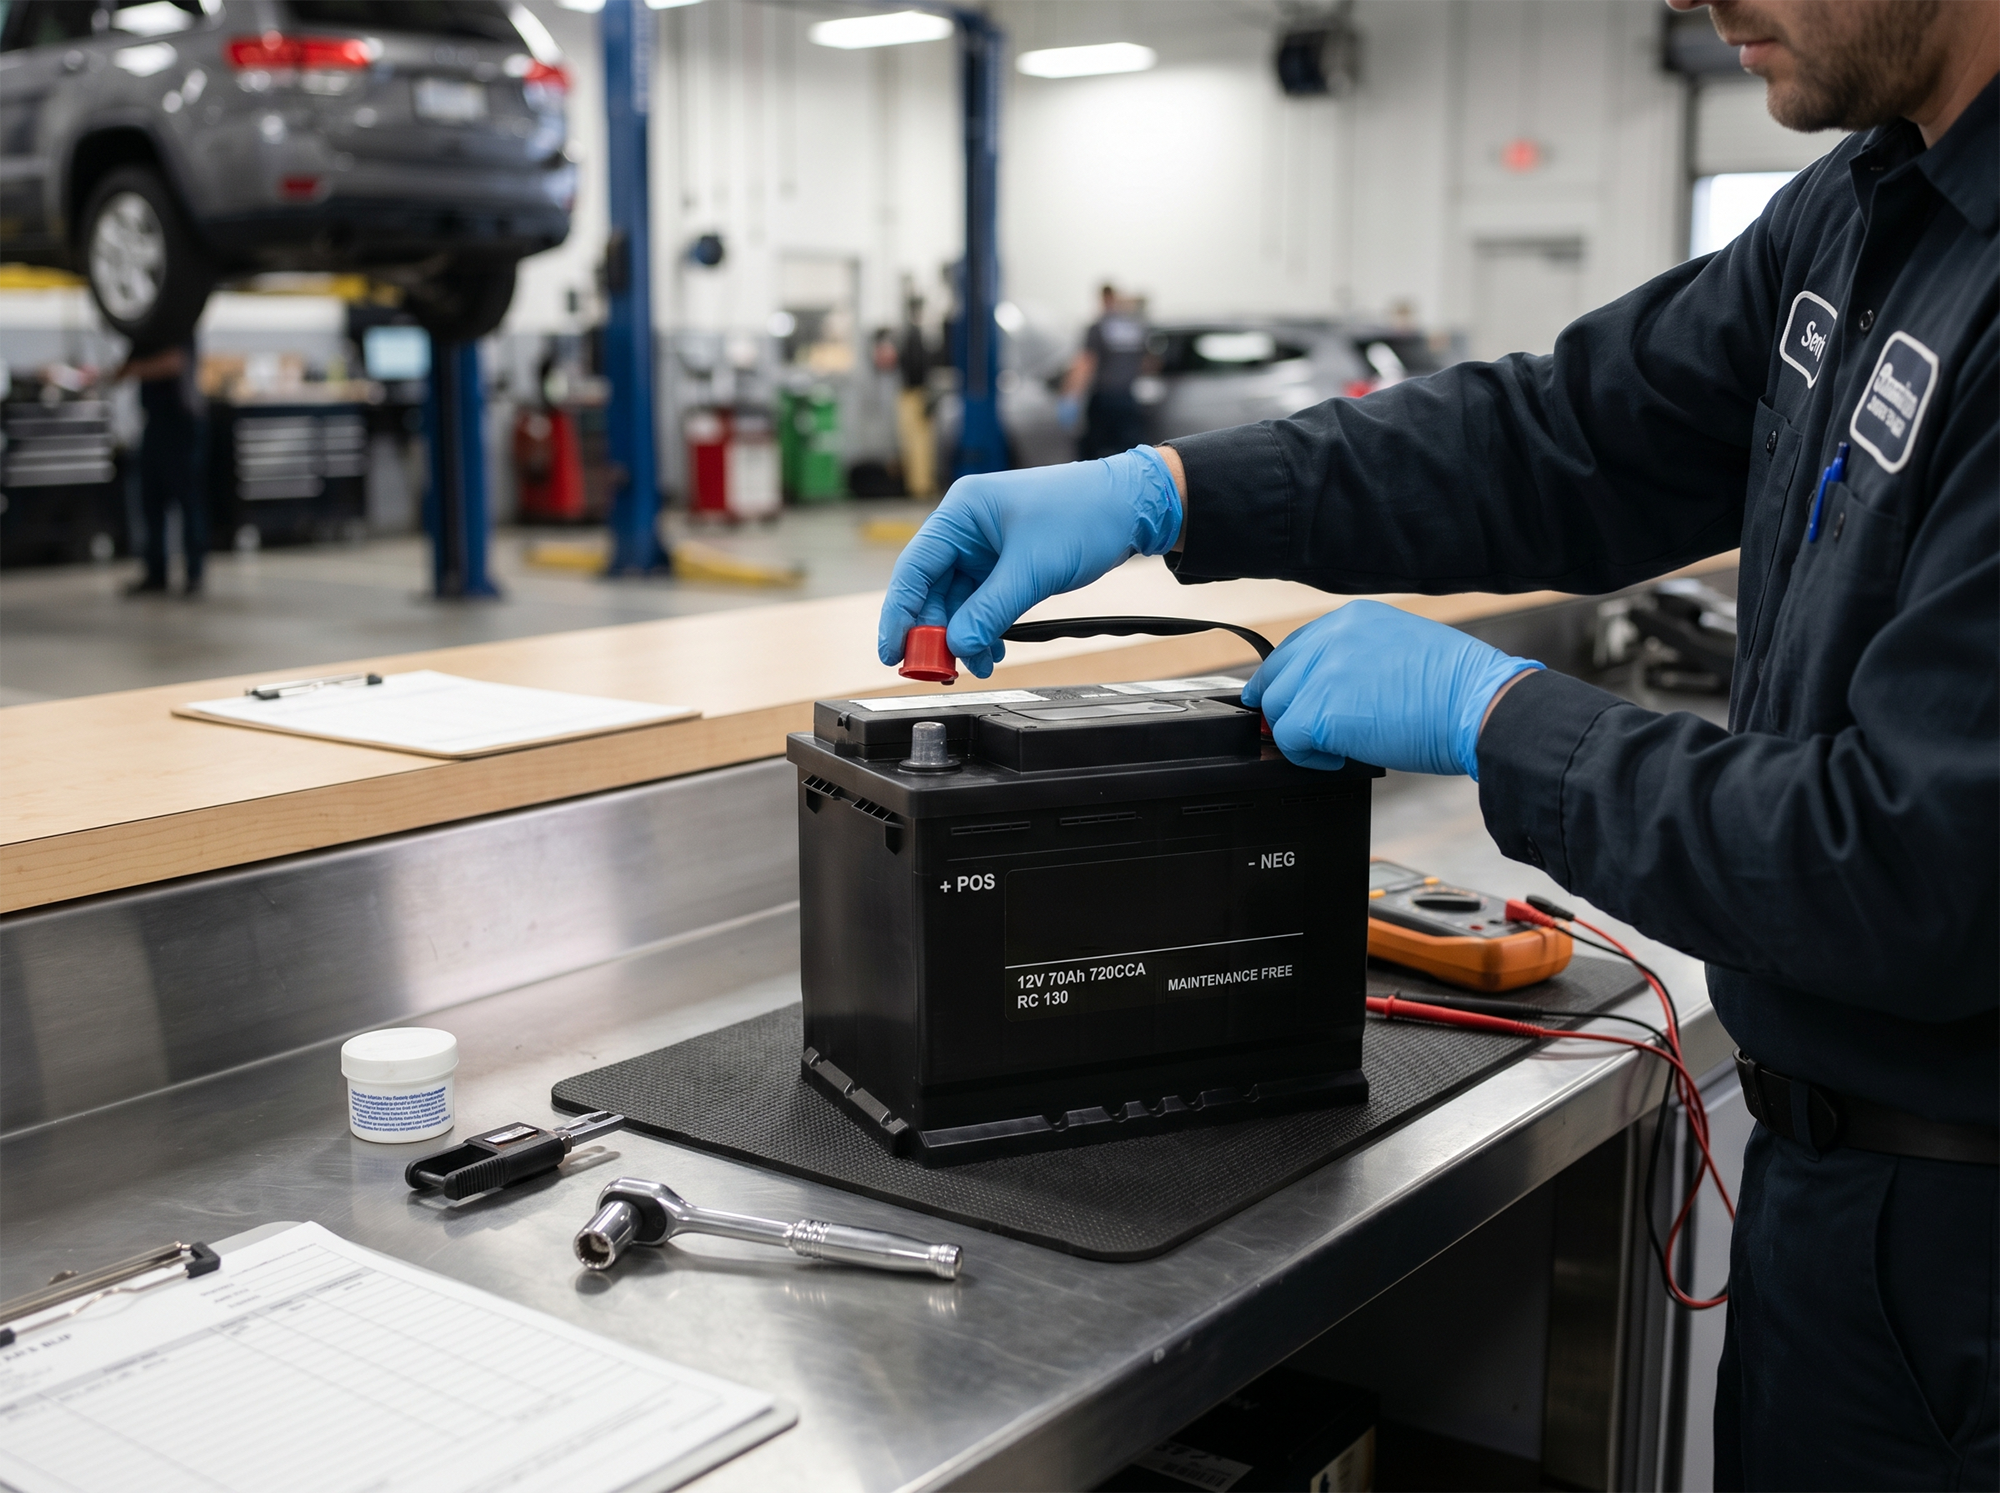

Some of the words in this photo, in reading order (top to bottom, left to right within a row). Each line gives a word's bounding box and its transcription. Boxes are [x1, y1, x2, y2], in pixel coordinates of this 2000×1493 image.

[1260, 851, 1295, 870] NEG
[957, 873, 996, 893] POS
[1017, 973, 1045, 990] 12V
[1048, 969, 1086, 986] 70Ah
[1089, 962, 1147, 982] 720CCA
[1167, 967, 1258, 992] MAINTENANCE
[1261, 964, 1293, 981] FREE
[1017, 993, 1039, 1009] RC
[1043, 989, 1069, 1006] 130
